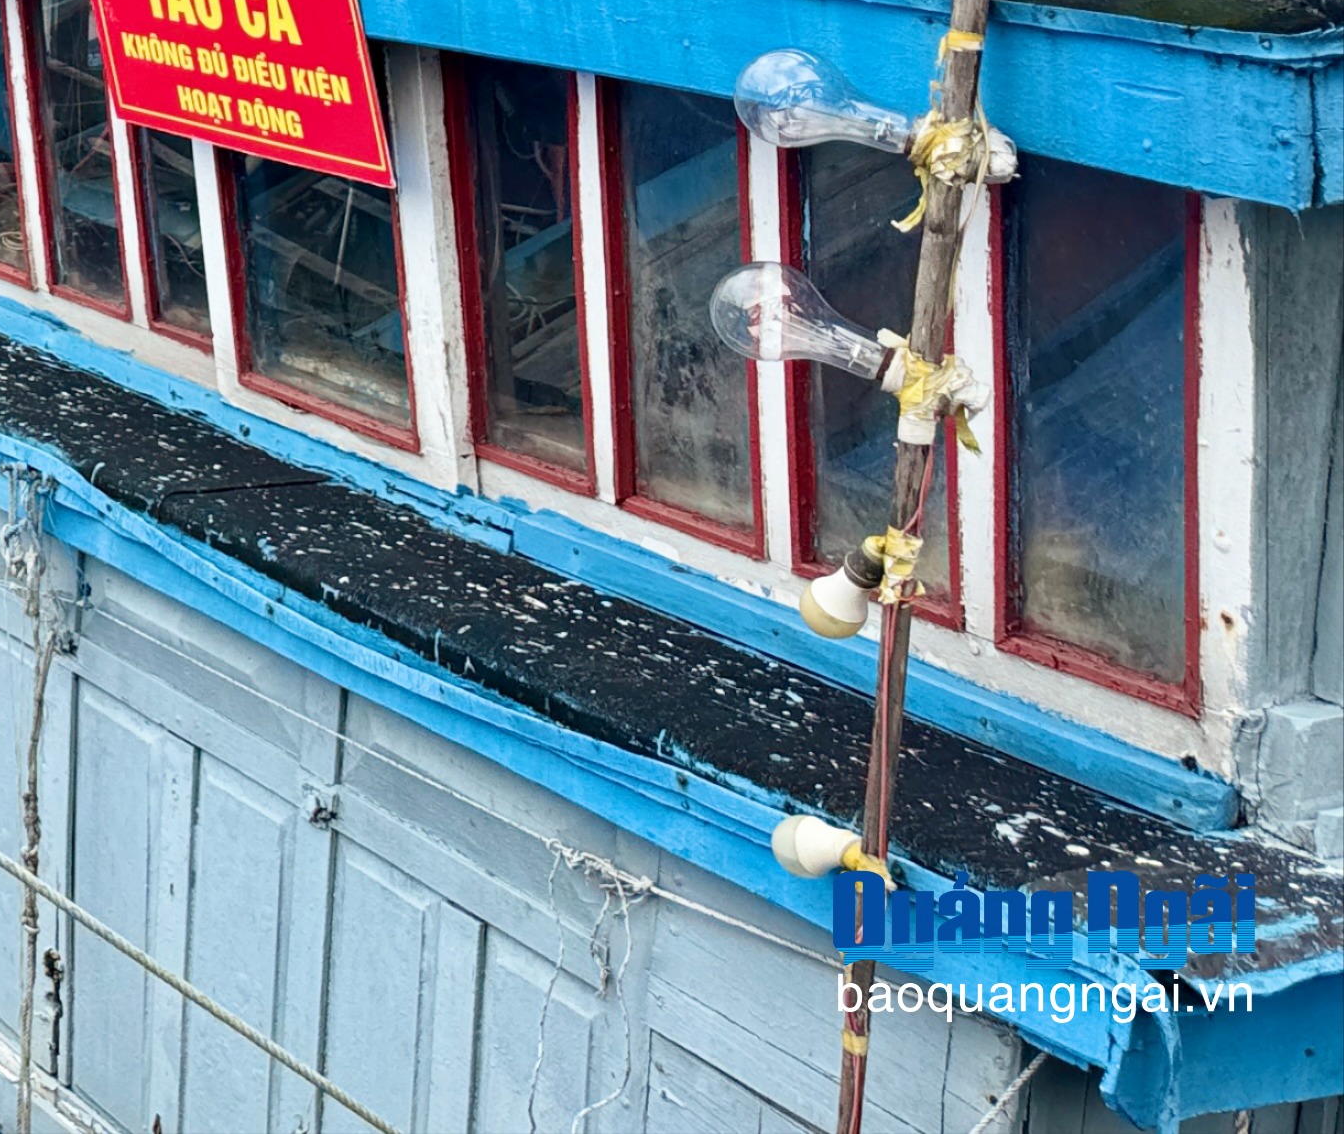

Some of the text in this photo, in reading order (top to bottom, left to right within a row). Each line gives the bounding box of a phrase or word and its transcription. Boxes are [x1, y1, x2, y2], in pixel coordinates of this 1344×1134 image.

[120, 31, 353, 107] KHÔNG ĐỦ ĐIỀU KIỆN
[176, 84, 304, 139] HOẠT ĐỘNG
